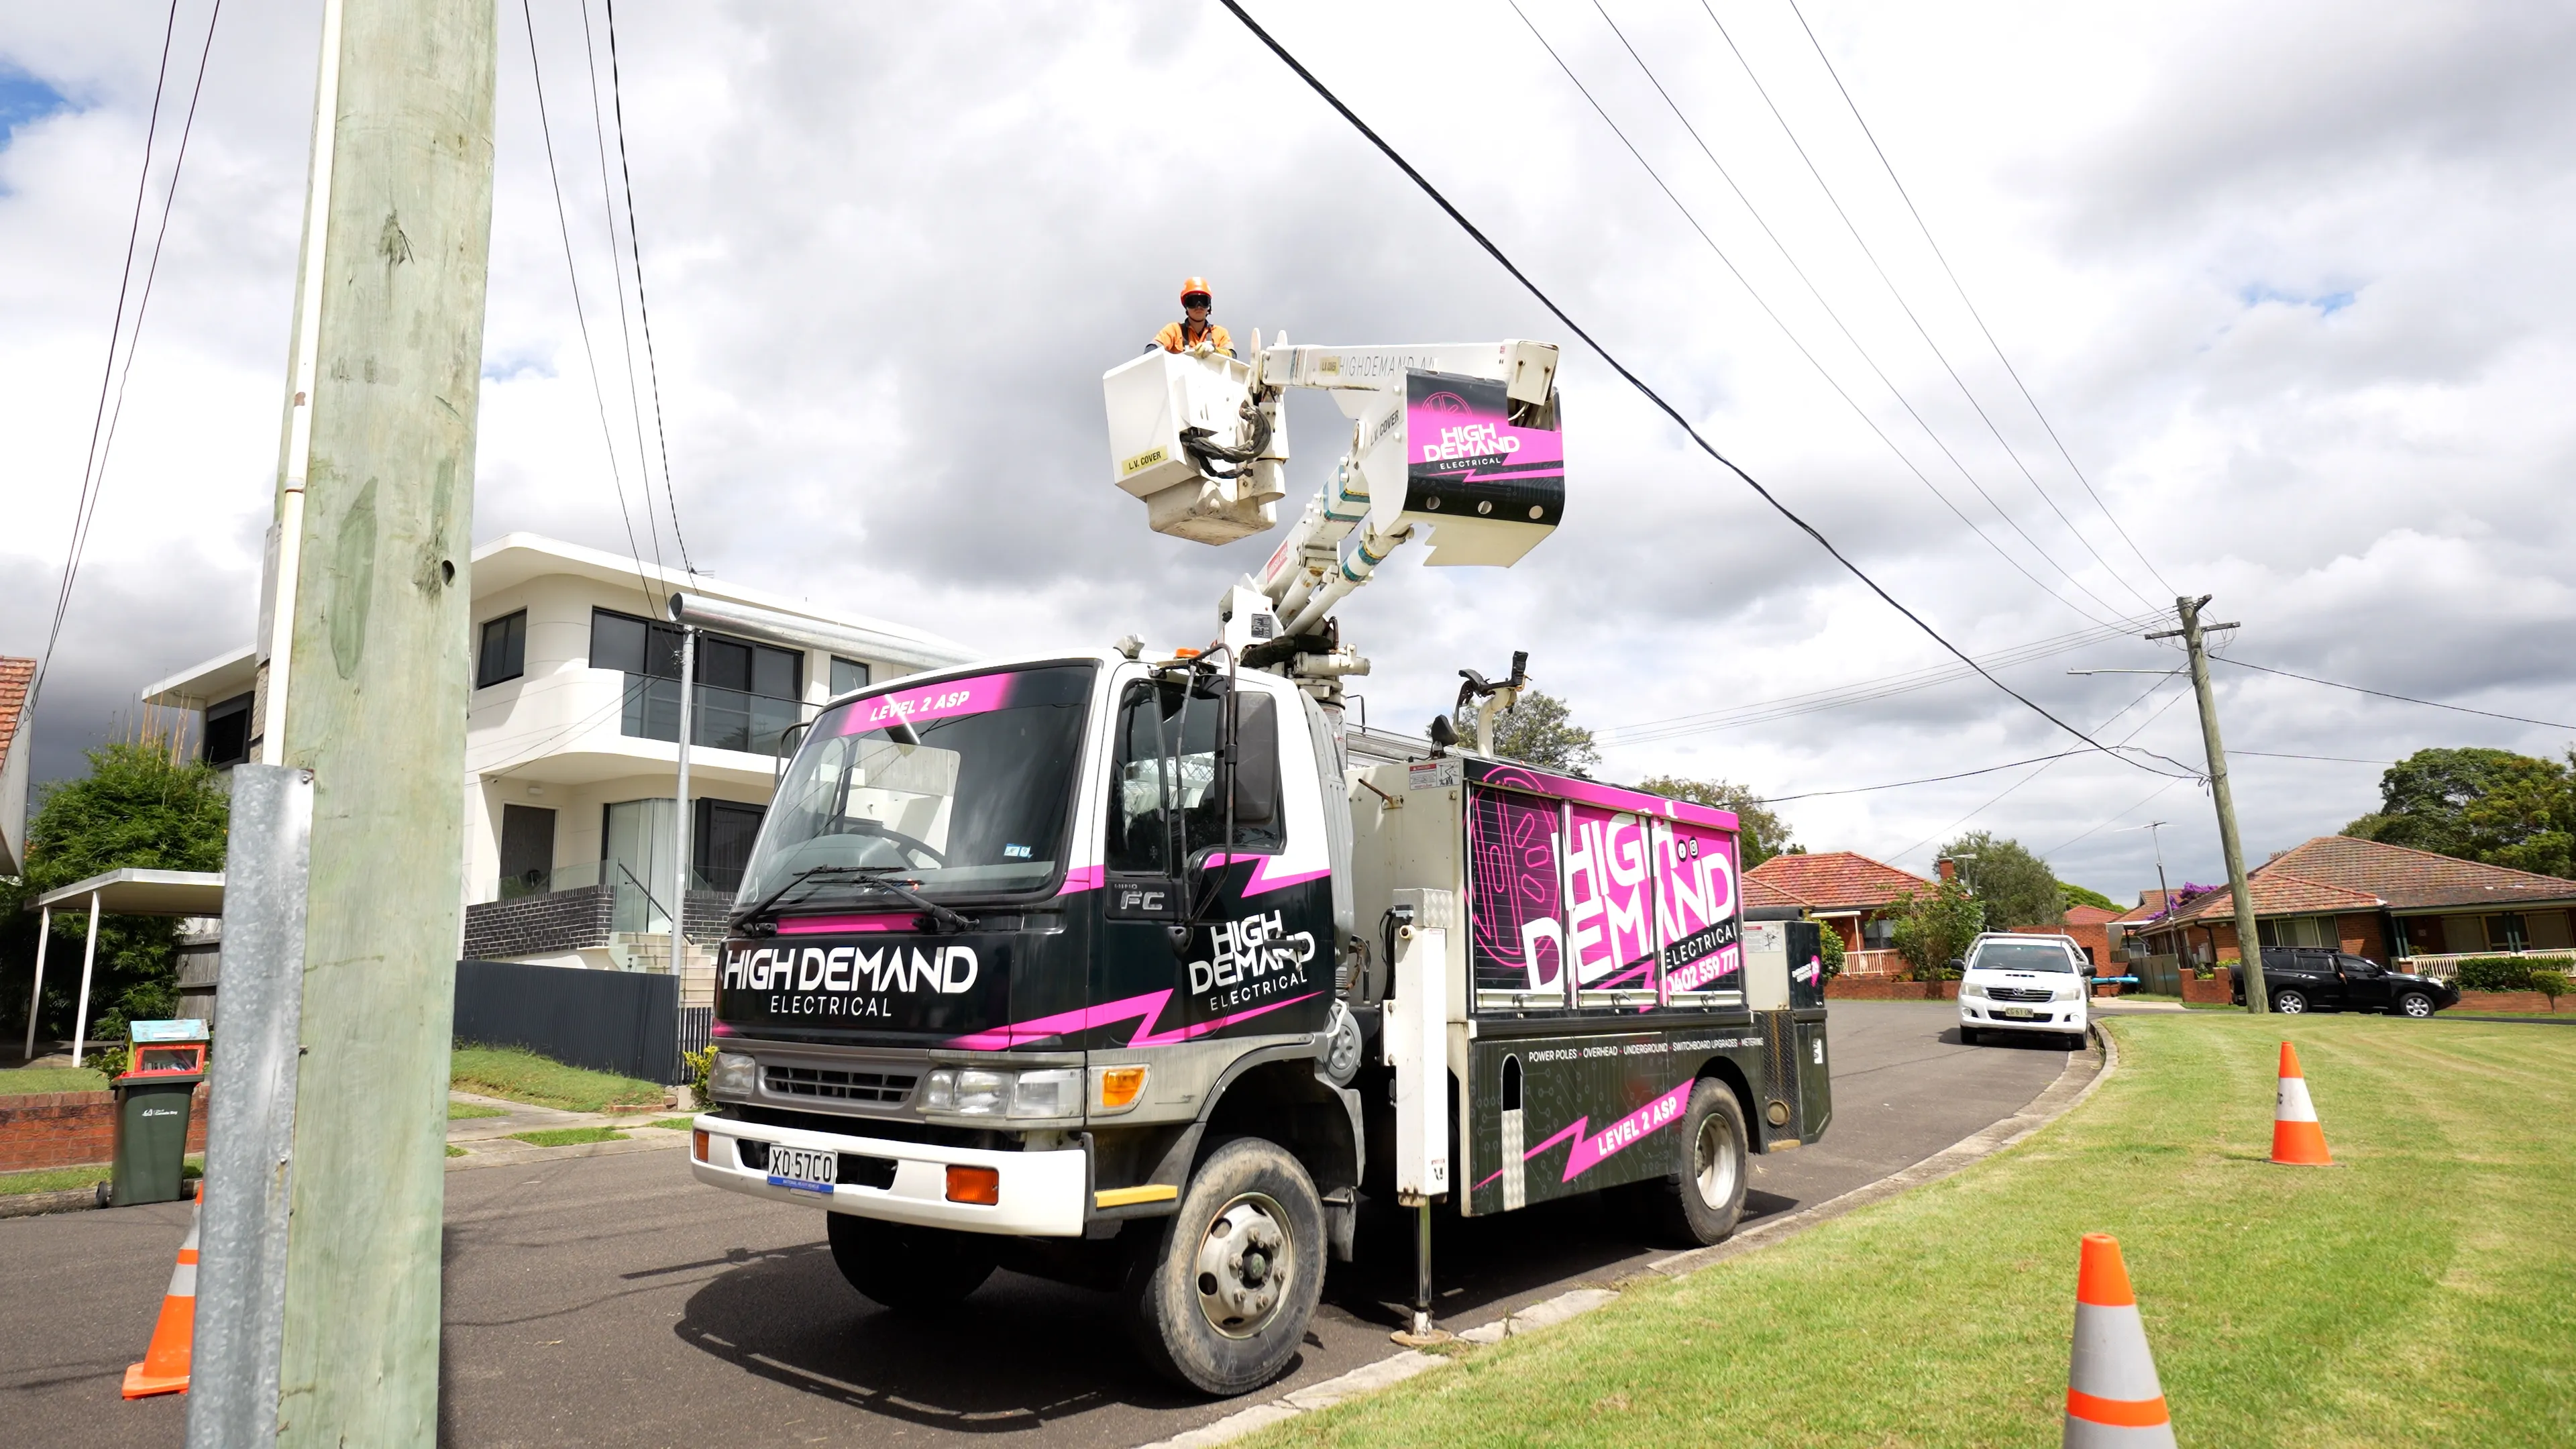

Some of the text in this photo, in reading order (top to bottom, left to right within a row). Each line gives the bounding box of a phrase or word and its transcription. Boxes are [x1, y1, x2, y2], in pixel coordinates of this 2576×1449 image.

[1380, 409, 1399, 436] COVER
[1441, 423, 1497, 445] HIGH
[1128, 451, 1161, 470] L.V. COVER
[1423, 436, 1520, 462] DEMAND
[1440, 457, 1501, 470] ELECTRICAL
[869, 690, 970, 722] LEVEL 2 ASP
[1550, 801, 1678, 911] HIGH
[1120, 890, 1165, 910] FC
[1210, 909, 1283, 957] HIGH
[1521, 853, 1735, 991] DEMAND
[723, 945, 979, 994] HIGH DEMAND
[1189, 931, 1316, 996] DEMAND
[1699, 955, 1720, 982] 559
[1210, 970, 1307, 1011] ELECTRICAL
[770, 995, 892, 1017] ELECTRICAL
[1528, 1036, 1764, 1063] POWER POLES OVERHEAD UNDERGROUND SWITCHBOARD UPGRADES METERING
[1597, 1096, 1677, 1157] LEVEL 2 ASP
